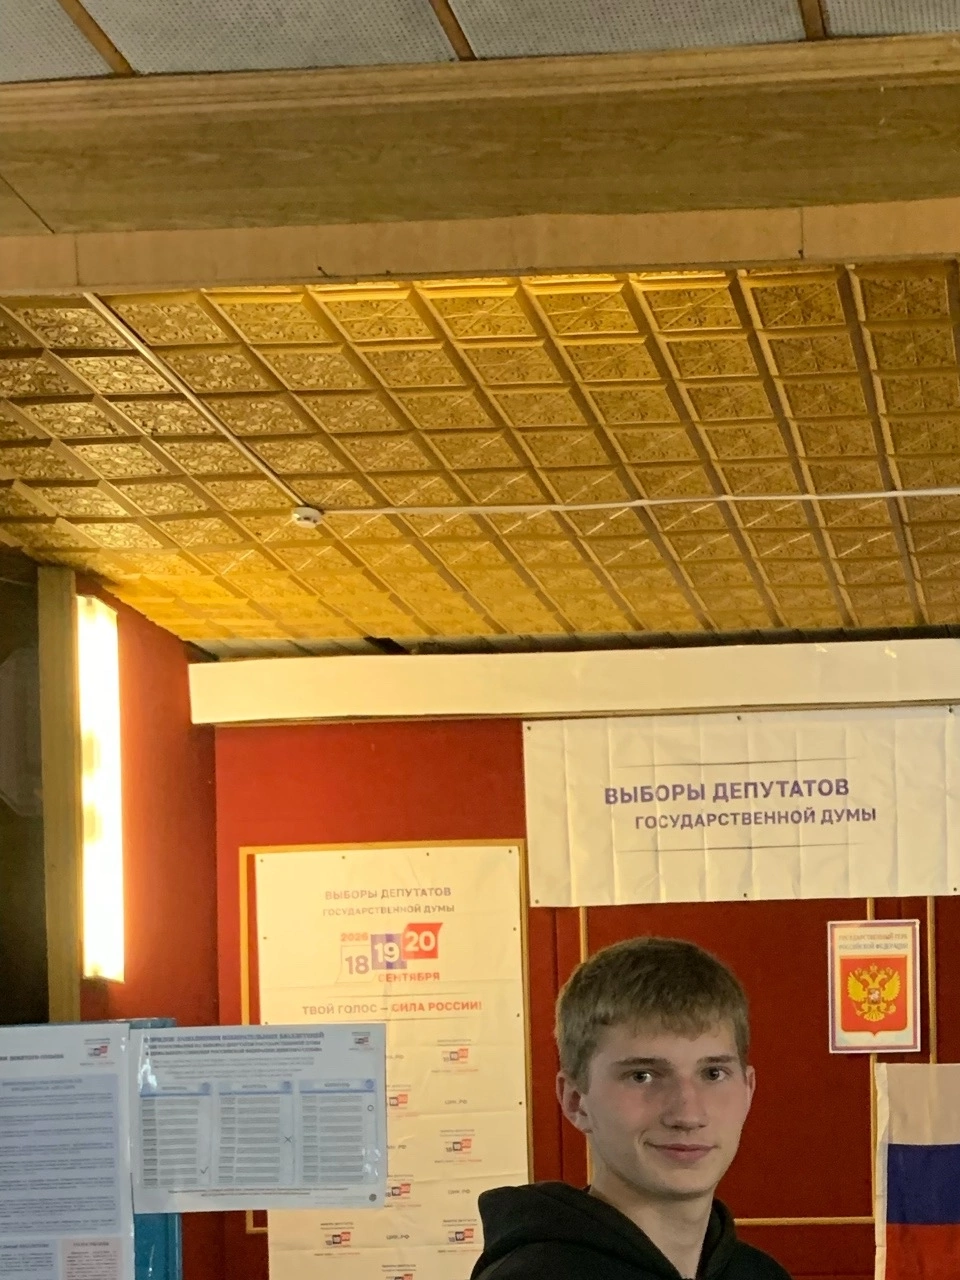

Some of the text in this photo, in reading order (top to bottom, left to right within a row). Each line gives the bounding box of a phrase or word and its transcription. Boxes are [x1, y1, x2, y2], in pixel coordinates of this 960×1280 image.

[604, 778, 850, 805] ВЫБОРЫ ДЕПУТАТОВ
[635, 807, 877, 830] ГОСУДАРСТВЕННОЙ ДУМЫ
[324, 887, 452, 901] ВЫБОРЫ ДЕПУТАТОВ
[322, 903, 455, 917] ГОСУДАРСТВЕННОЙ ДУМЫ
[345, 930, 436, 975] 18 19 20
[378, 972, 441, 983] СЕНТЯБРЯ
[302, 1003, 335, 1015] ТВОЙ
[337, 1004, 377, 1015] ГОЛОС
[391, 1002, 425, 1013] СИЛА
[428, 1001, 482, 1012] РОССИИ!
